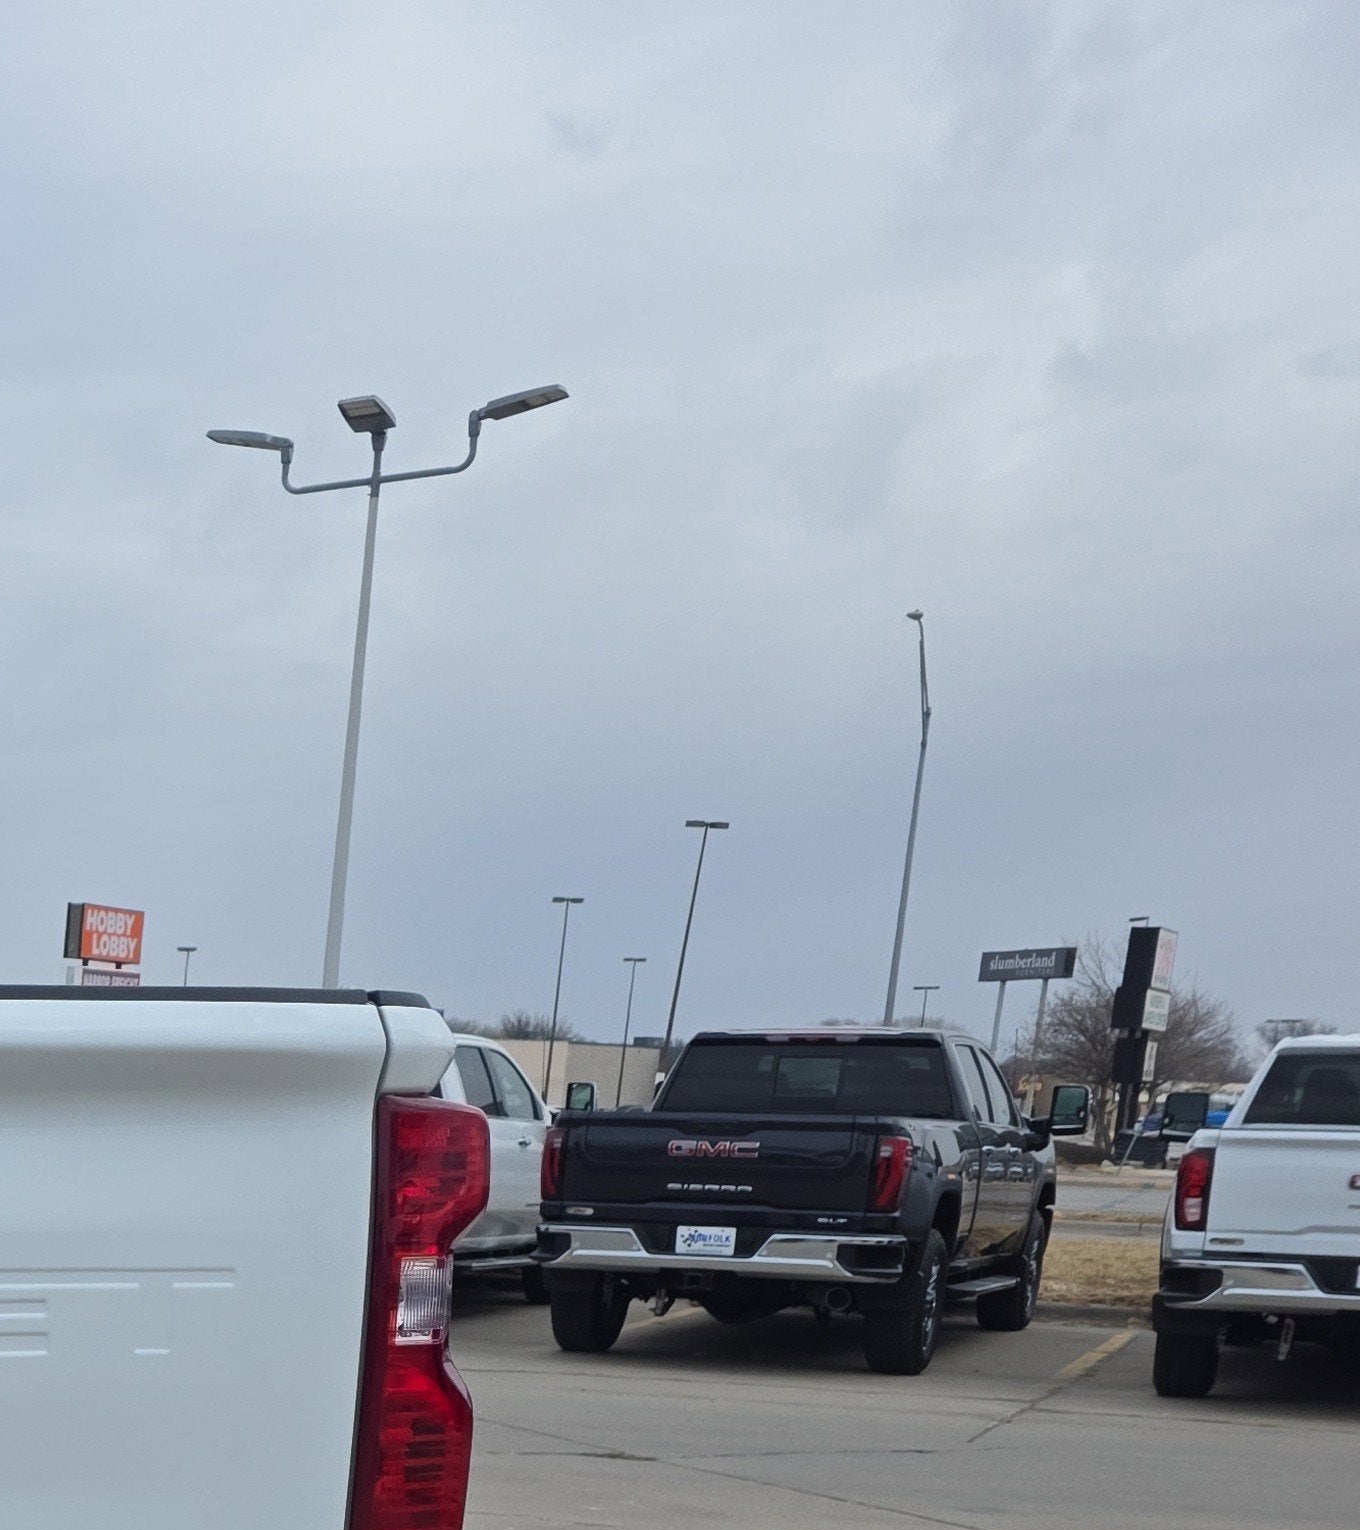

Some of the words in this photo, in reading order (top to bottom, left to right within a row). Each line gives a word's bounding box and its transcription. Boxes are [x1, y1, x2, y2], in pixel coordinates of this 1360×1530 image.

[87, 909, 135, 935] HOBBY
[92, 933, 138, 959] LOBBY
[990, 952, 1056, 970] slumberland
[667, 1139, 760, 1158] GMC
